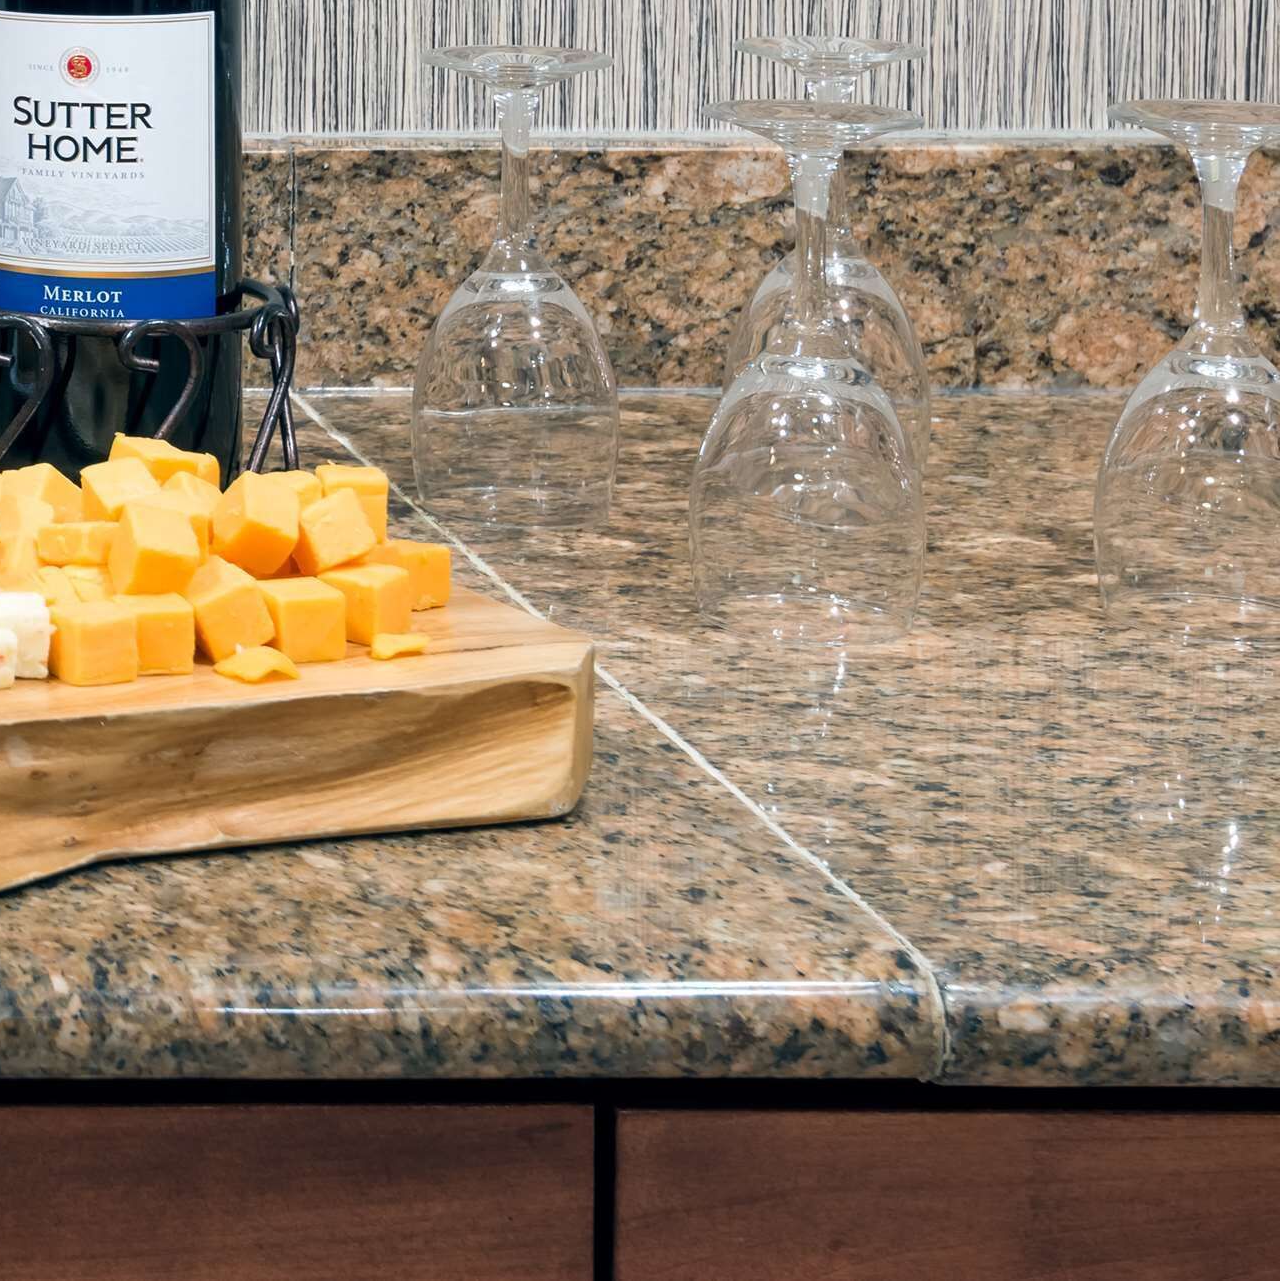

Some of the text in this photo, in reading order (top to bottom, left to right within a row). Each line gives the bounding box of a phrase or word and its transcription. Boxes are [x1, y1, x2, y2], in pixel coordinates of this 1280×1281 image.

[13, 96, 152, 129] SUTTER
[28, 134, 138, 163] HOME
[21, 168, 145, 180] FAMILY VINEYARDS
[21, 237, 143, 251] VINEYARD SELECT
[43, 285, 122, 303] MERLOT
[40, 306, 125, 317] CALIFORNIA
